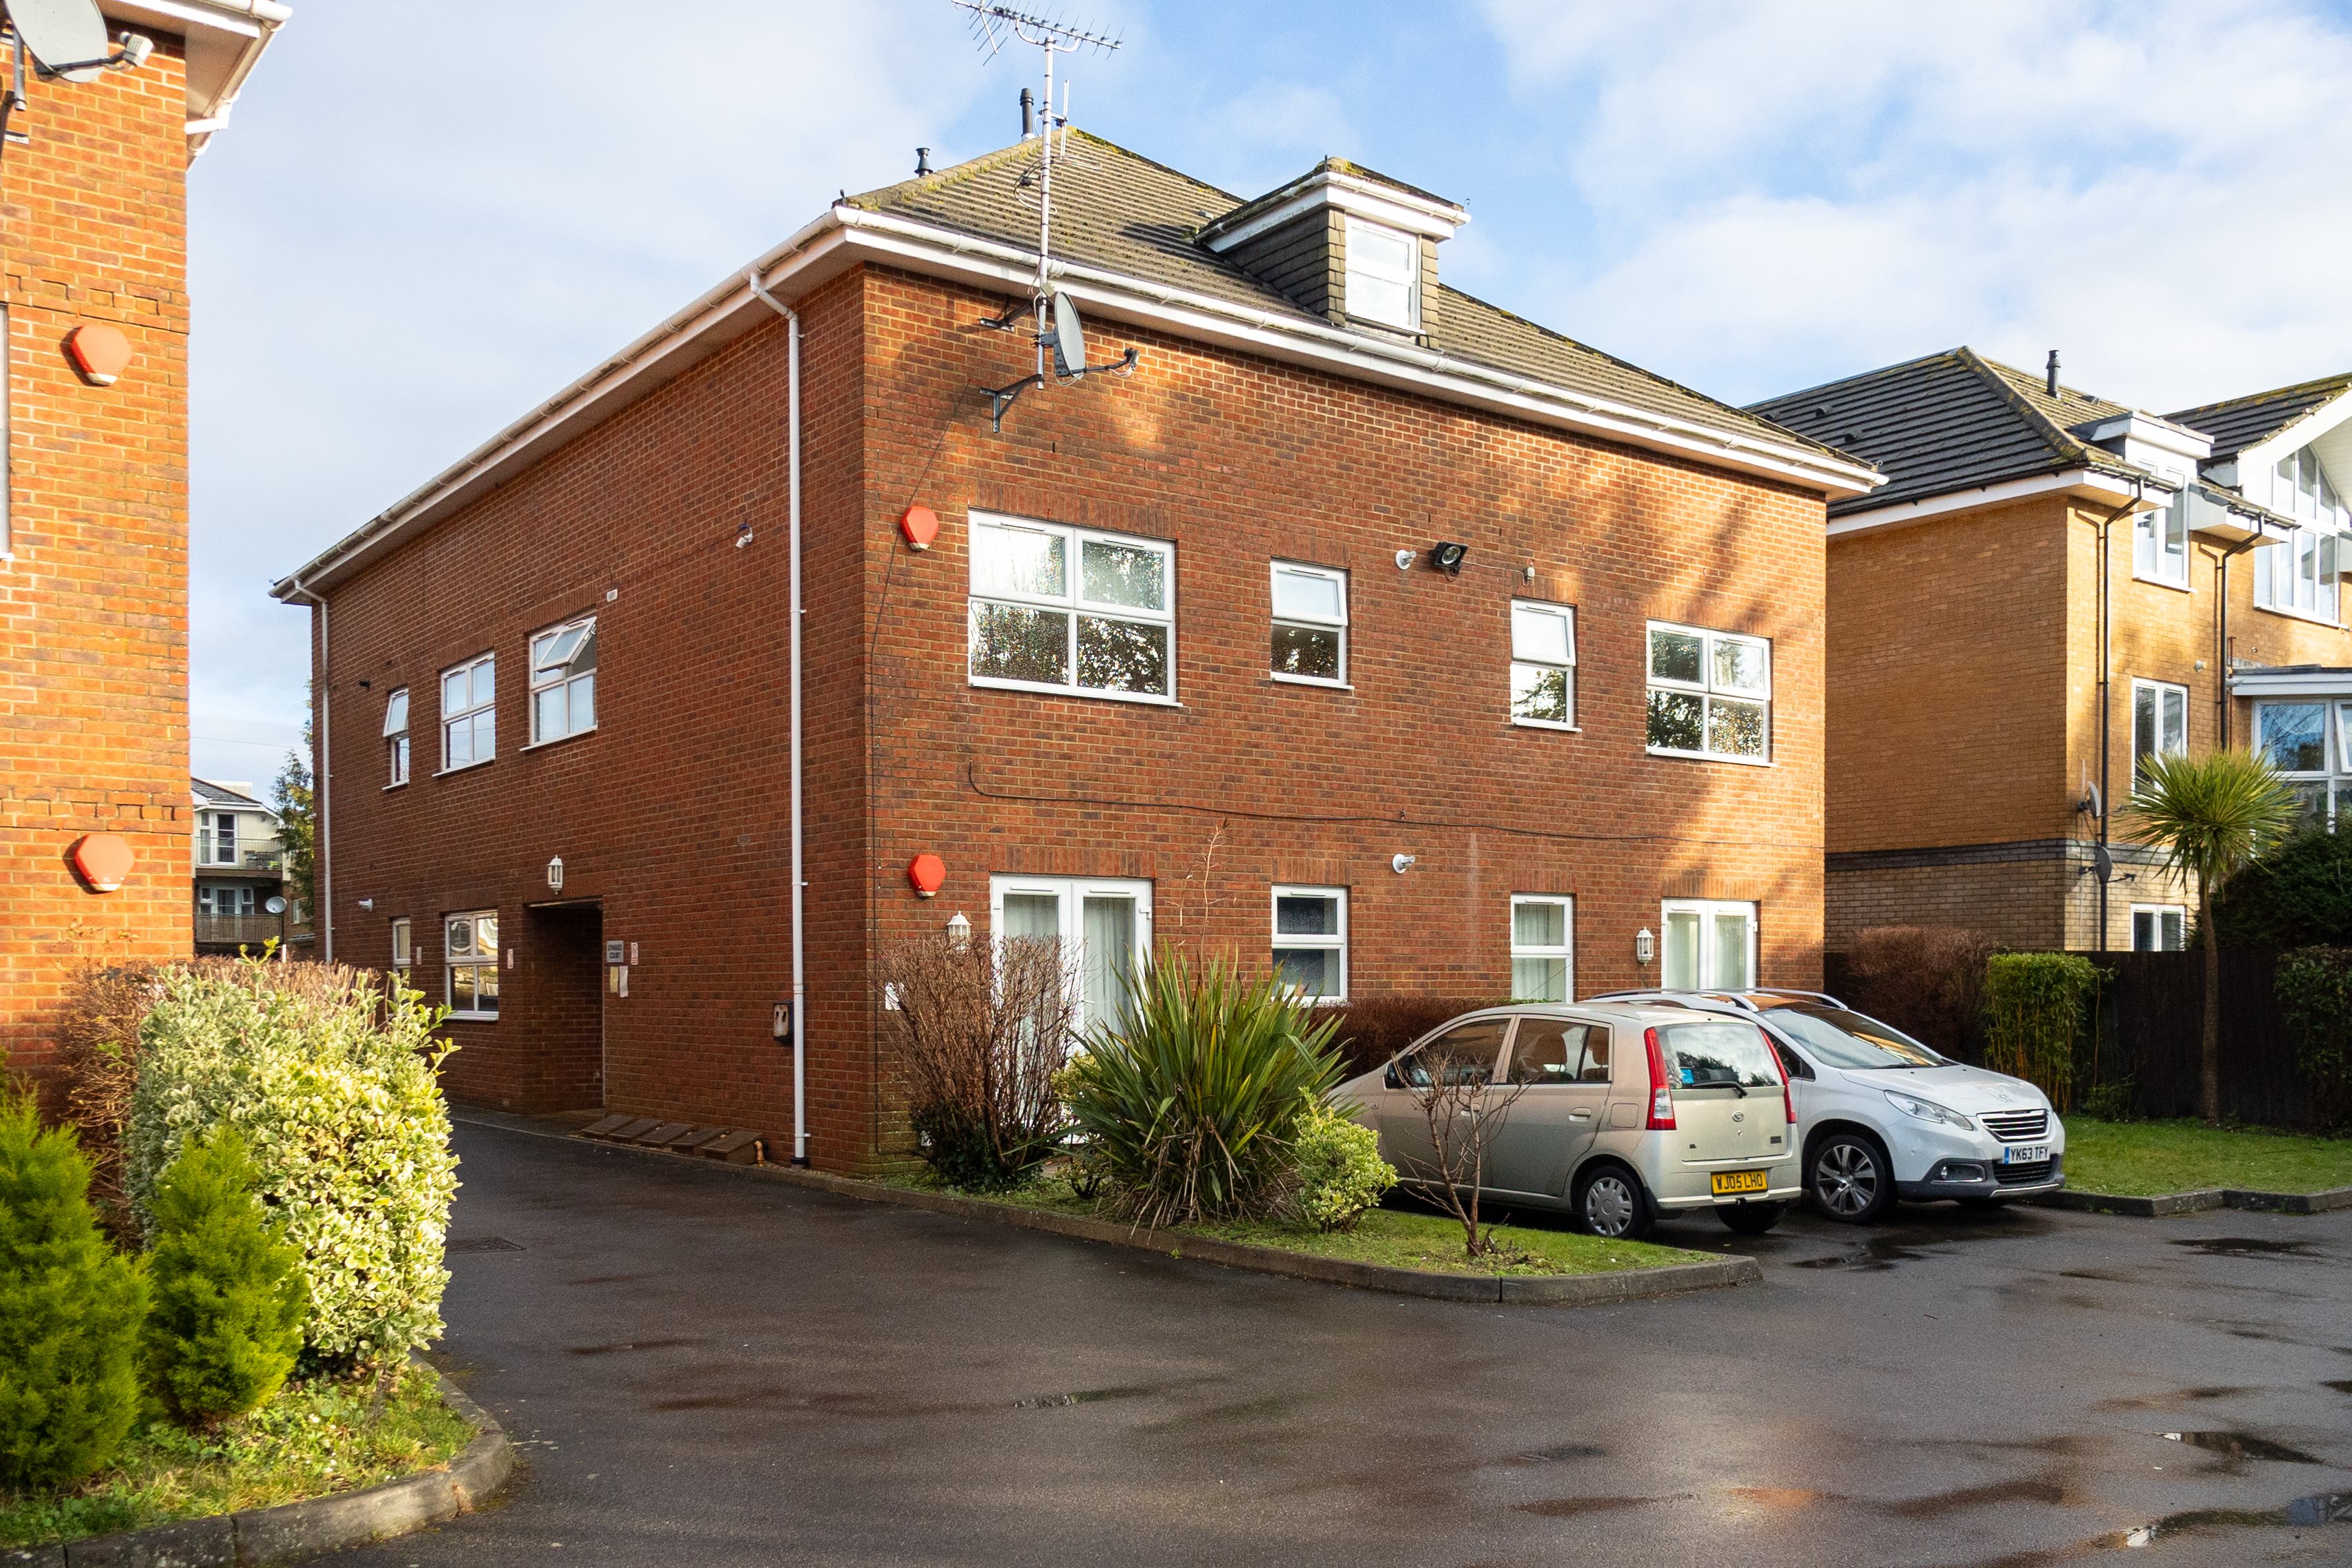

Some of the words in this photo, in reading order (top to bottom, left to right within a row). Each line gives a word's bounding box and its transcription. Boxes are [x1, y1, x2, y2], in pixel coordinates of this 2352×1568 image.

[2010, 1147, 2032, 1161] YK63
[2035, 1146, 2049, 1159] TFY
[1716, 1175, 1743, 1190] WJ05
[1744, 1173, 1763, 1188] LHO
